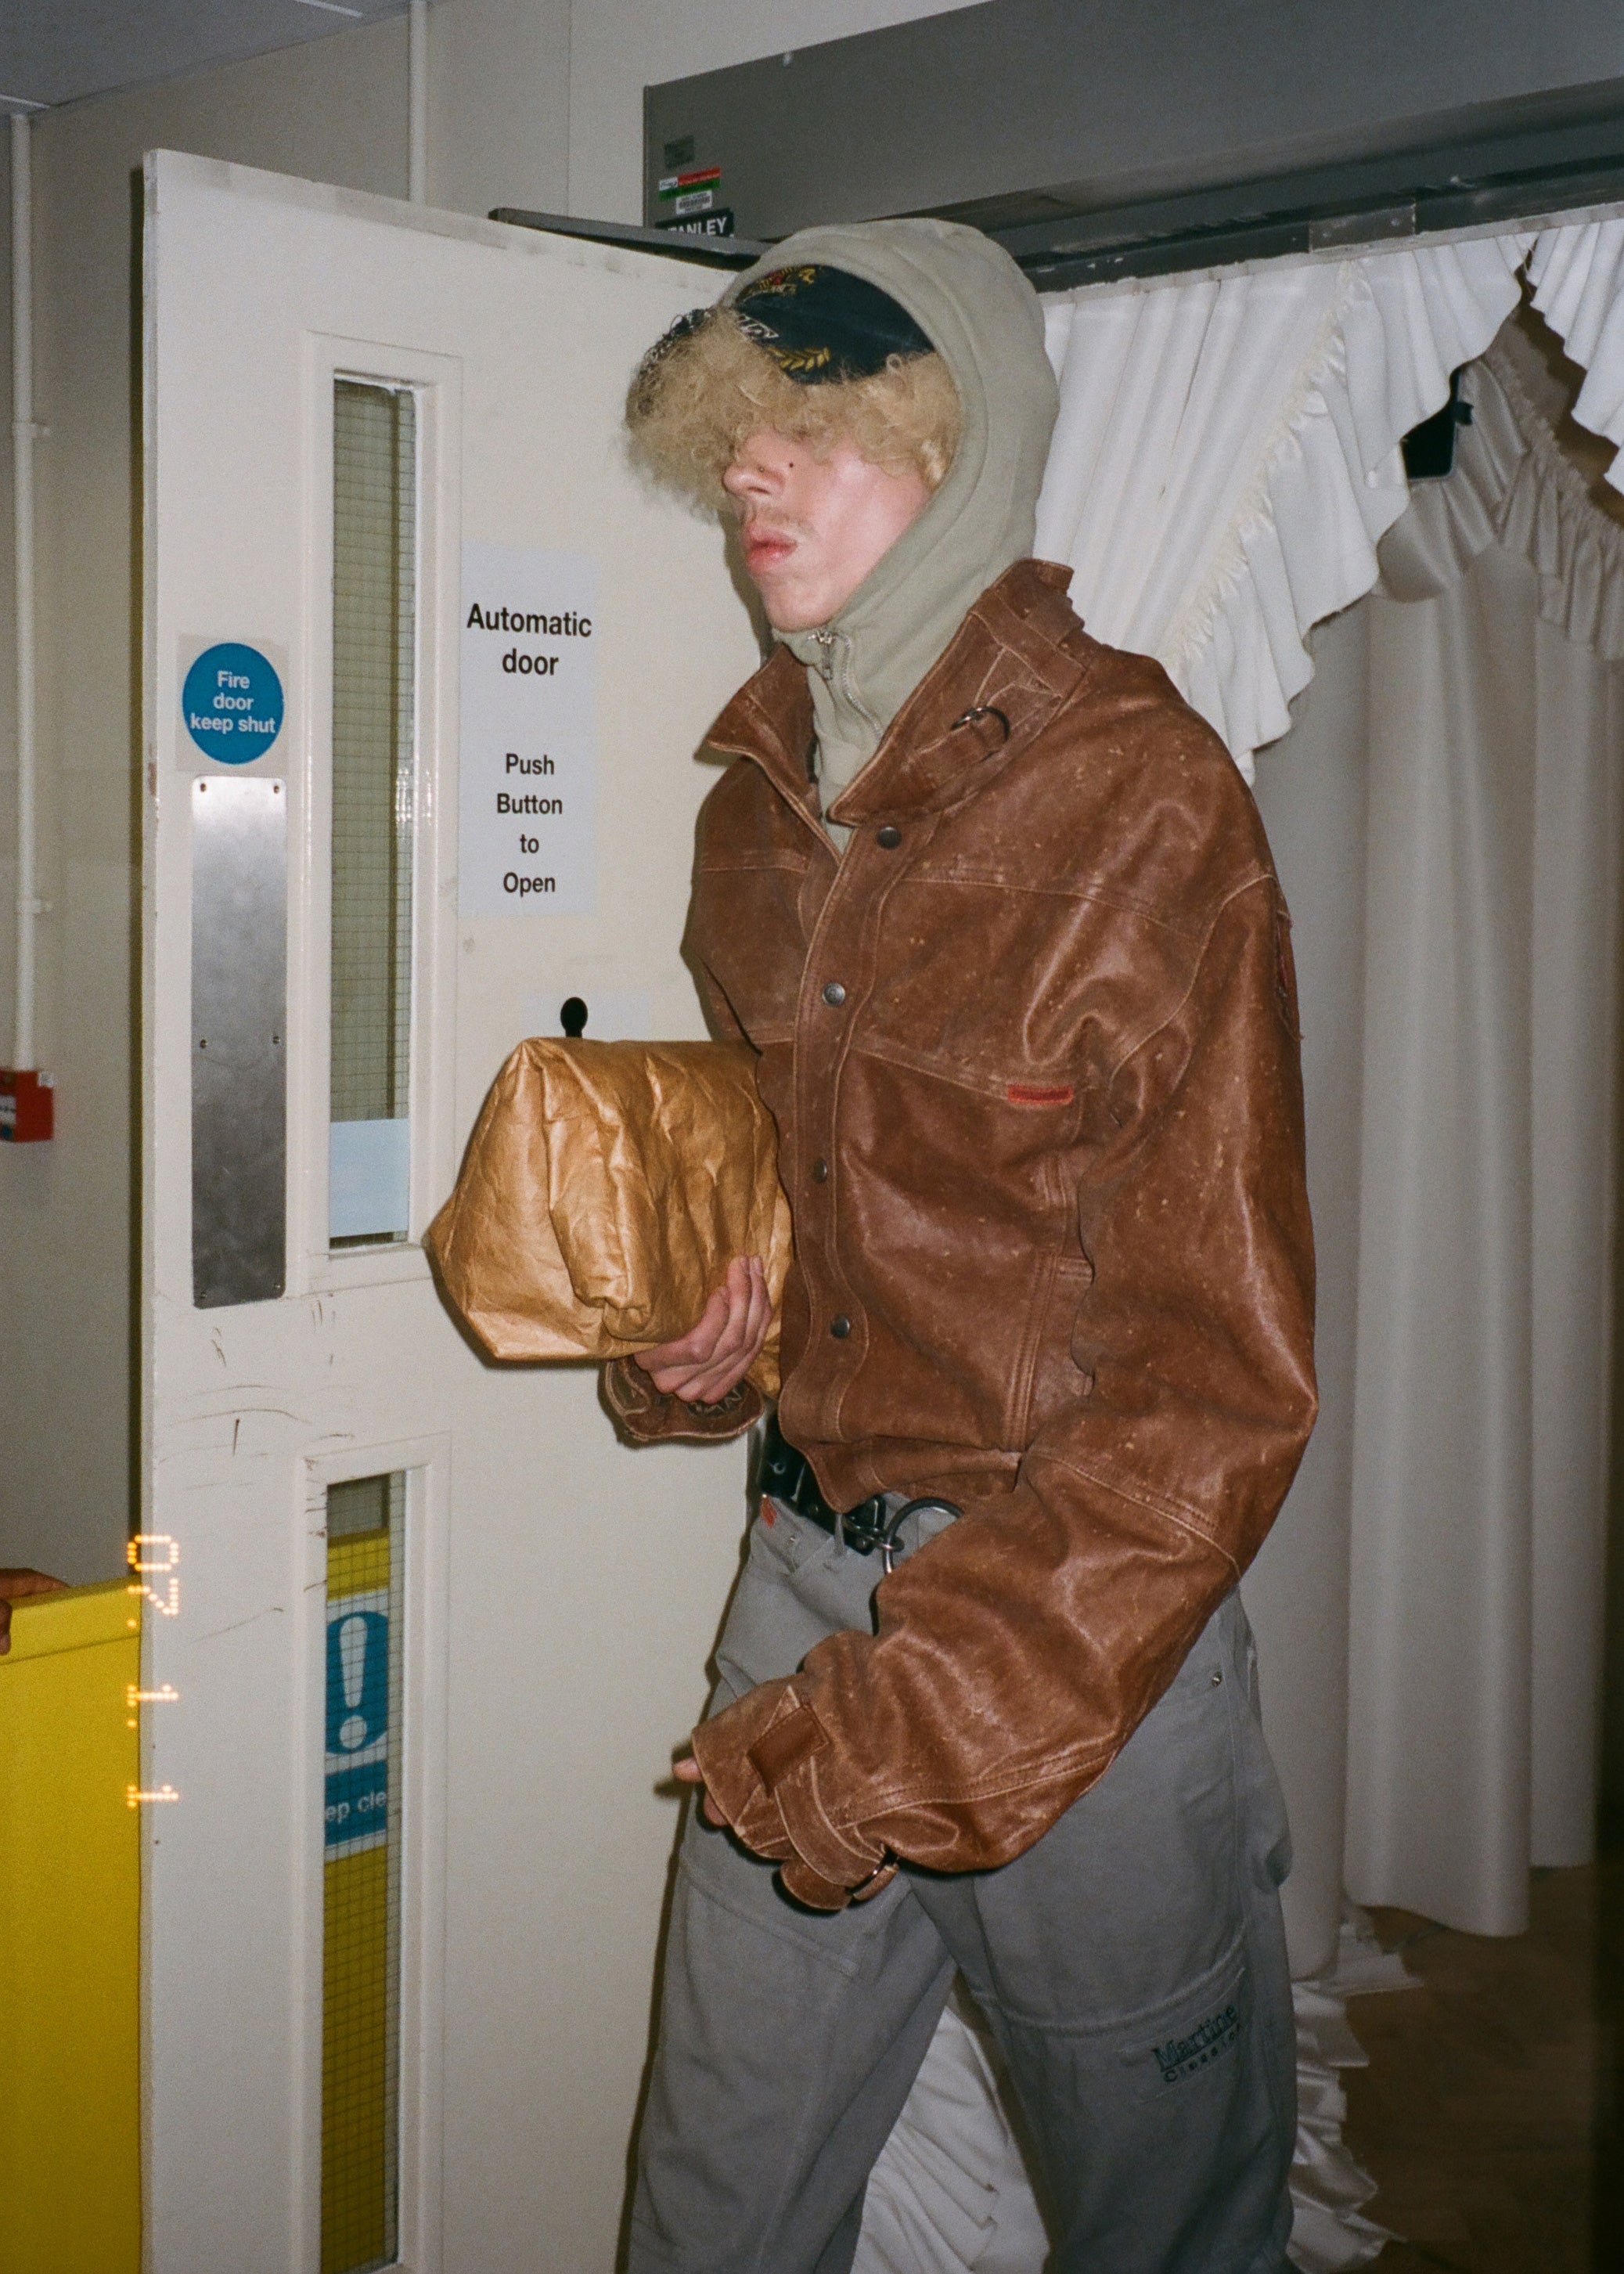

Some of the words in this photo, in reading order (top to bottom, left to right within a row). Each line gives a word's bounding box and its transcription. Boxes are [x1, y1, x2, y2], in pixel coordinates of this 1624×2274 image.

[668, 217, 727, 236] NLEY
[466, 603, 592, 637] Automatic
[502, 648, 560, 676] door
[217, 669, 250, 689] Fire
[213, 692, 254, 711] door
[189, 712, 234, 735] keep
[238, 715, 276, 733] shut
[505, 753, 555, 775] Push
[496, 793, 564, 815] Button
[520, 834, 540, 853] to
[502, 872, 556, 897] Open
[326, 1802, 351, 1825] ep
[358, 1790, 387, 1812] cle
[1151, 2005, 1237, 2073] Martine
